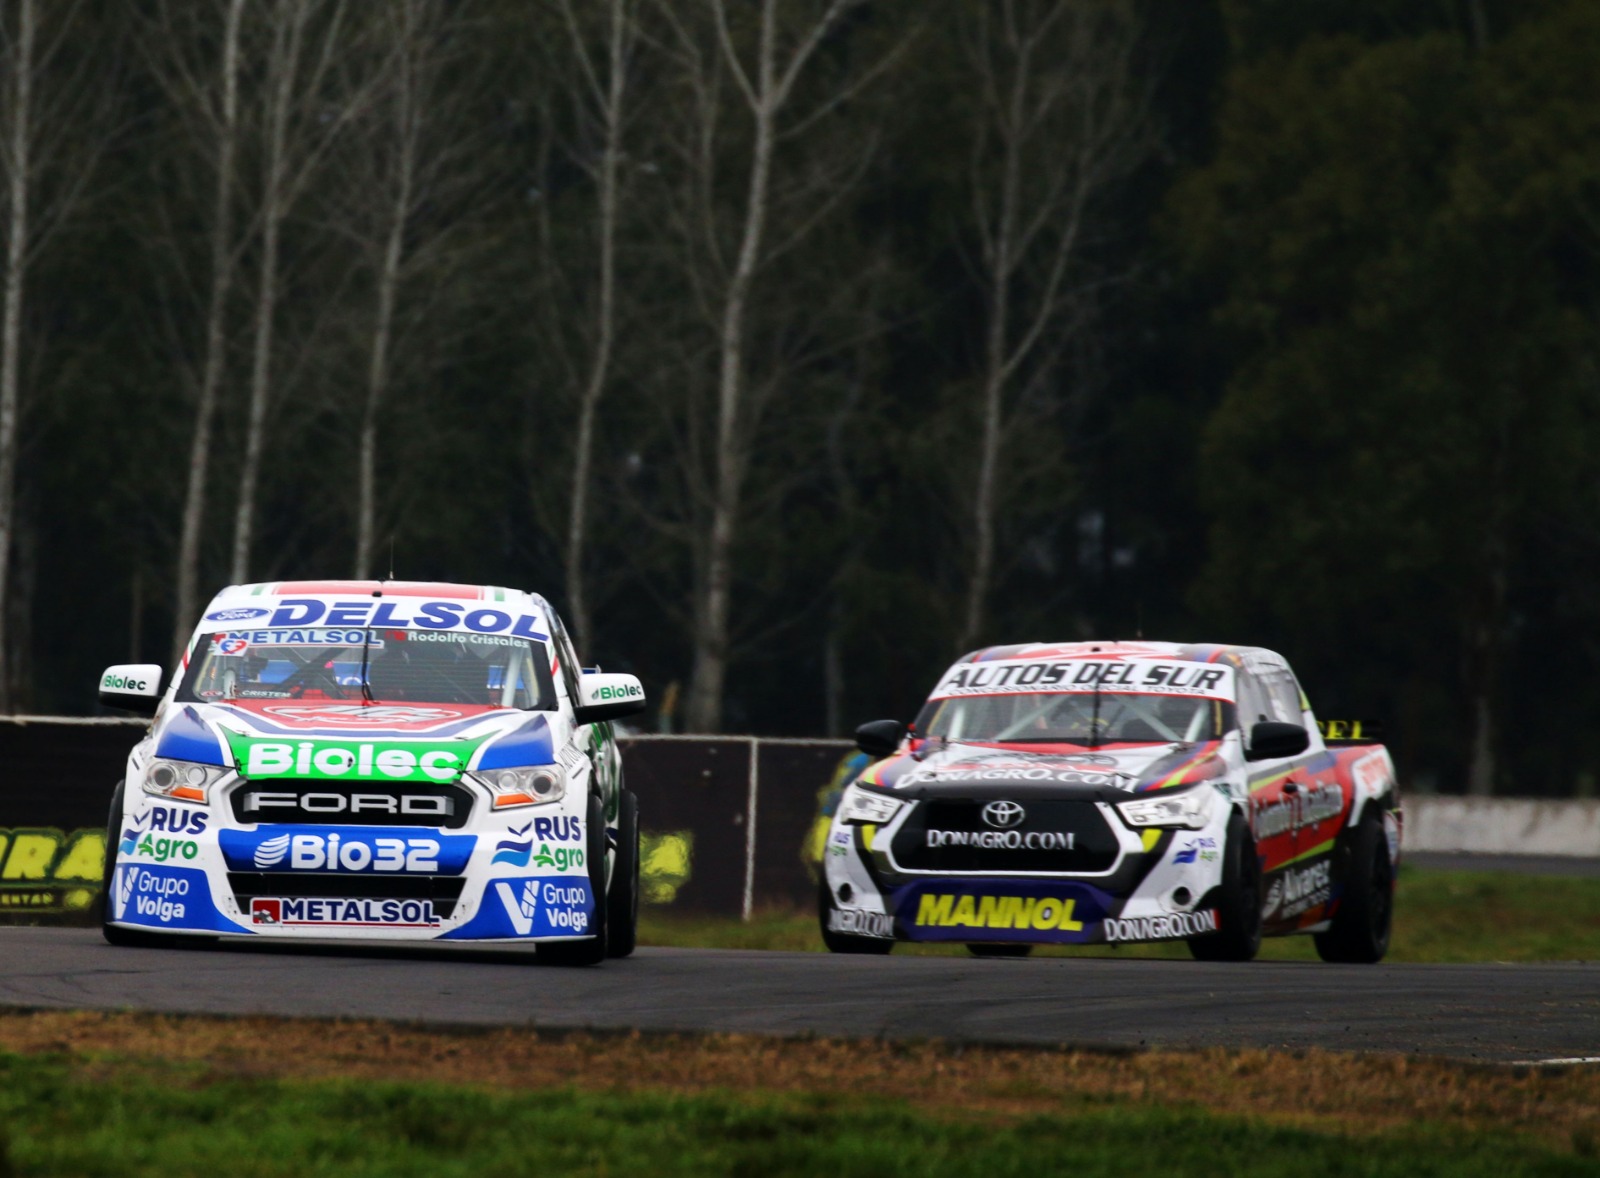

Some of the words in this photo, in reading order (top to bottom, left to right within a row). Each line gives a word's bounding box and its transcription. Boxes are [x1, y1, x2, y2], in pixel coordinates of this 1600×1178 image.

[268, 599, 549, 641] DELSOL
[228, 630, 381, 645] METALSOL
[407, 631, 466, 643] Rodolfo
[469, 635, 529, 648] Cristales
[104, 675, 147, 691] Biolec
[940, 663, 1071, 690] AUTOS
[1072, 663, 1137, 684] DEL
[1141, 665, 1225, 689] SUR
[600, 684, 642, 699] Biolec
[248, 742, 460, 780] Biolec
[244, 792, 454, 816] FORD
[150, 807, 208, 834] RUS
[534, 816, 581, 841] RUS
[138, 833, 198, 862] Agro
[291, 833, 440, 872] Bio32
[927, 830, 1075, 850] DONAGRO.COM
[533, 843, 584, 872] Agro
[138, 871, 189, 898] Grupo
[543, 883, 585, 908] Grupo
[136, 895, 185, 922] Volga
[282, 901, 440, 923] METALSOL
[546, 908, 588, 932] Volga
[915, 894, 1083, 931] MANNOL
